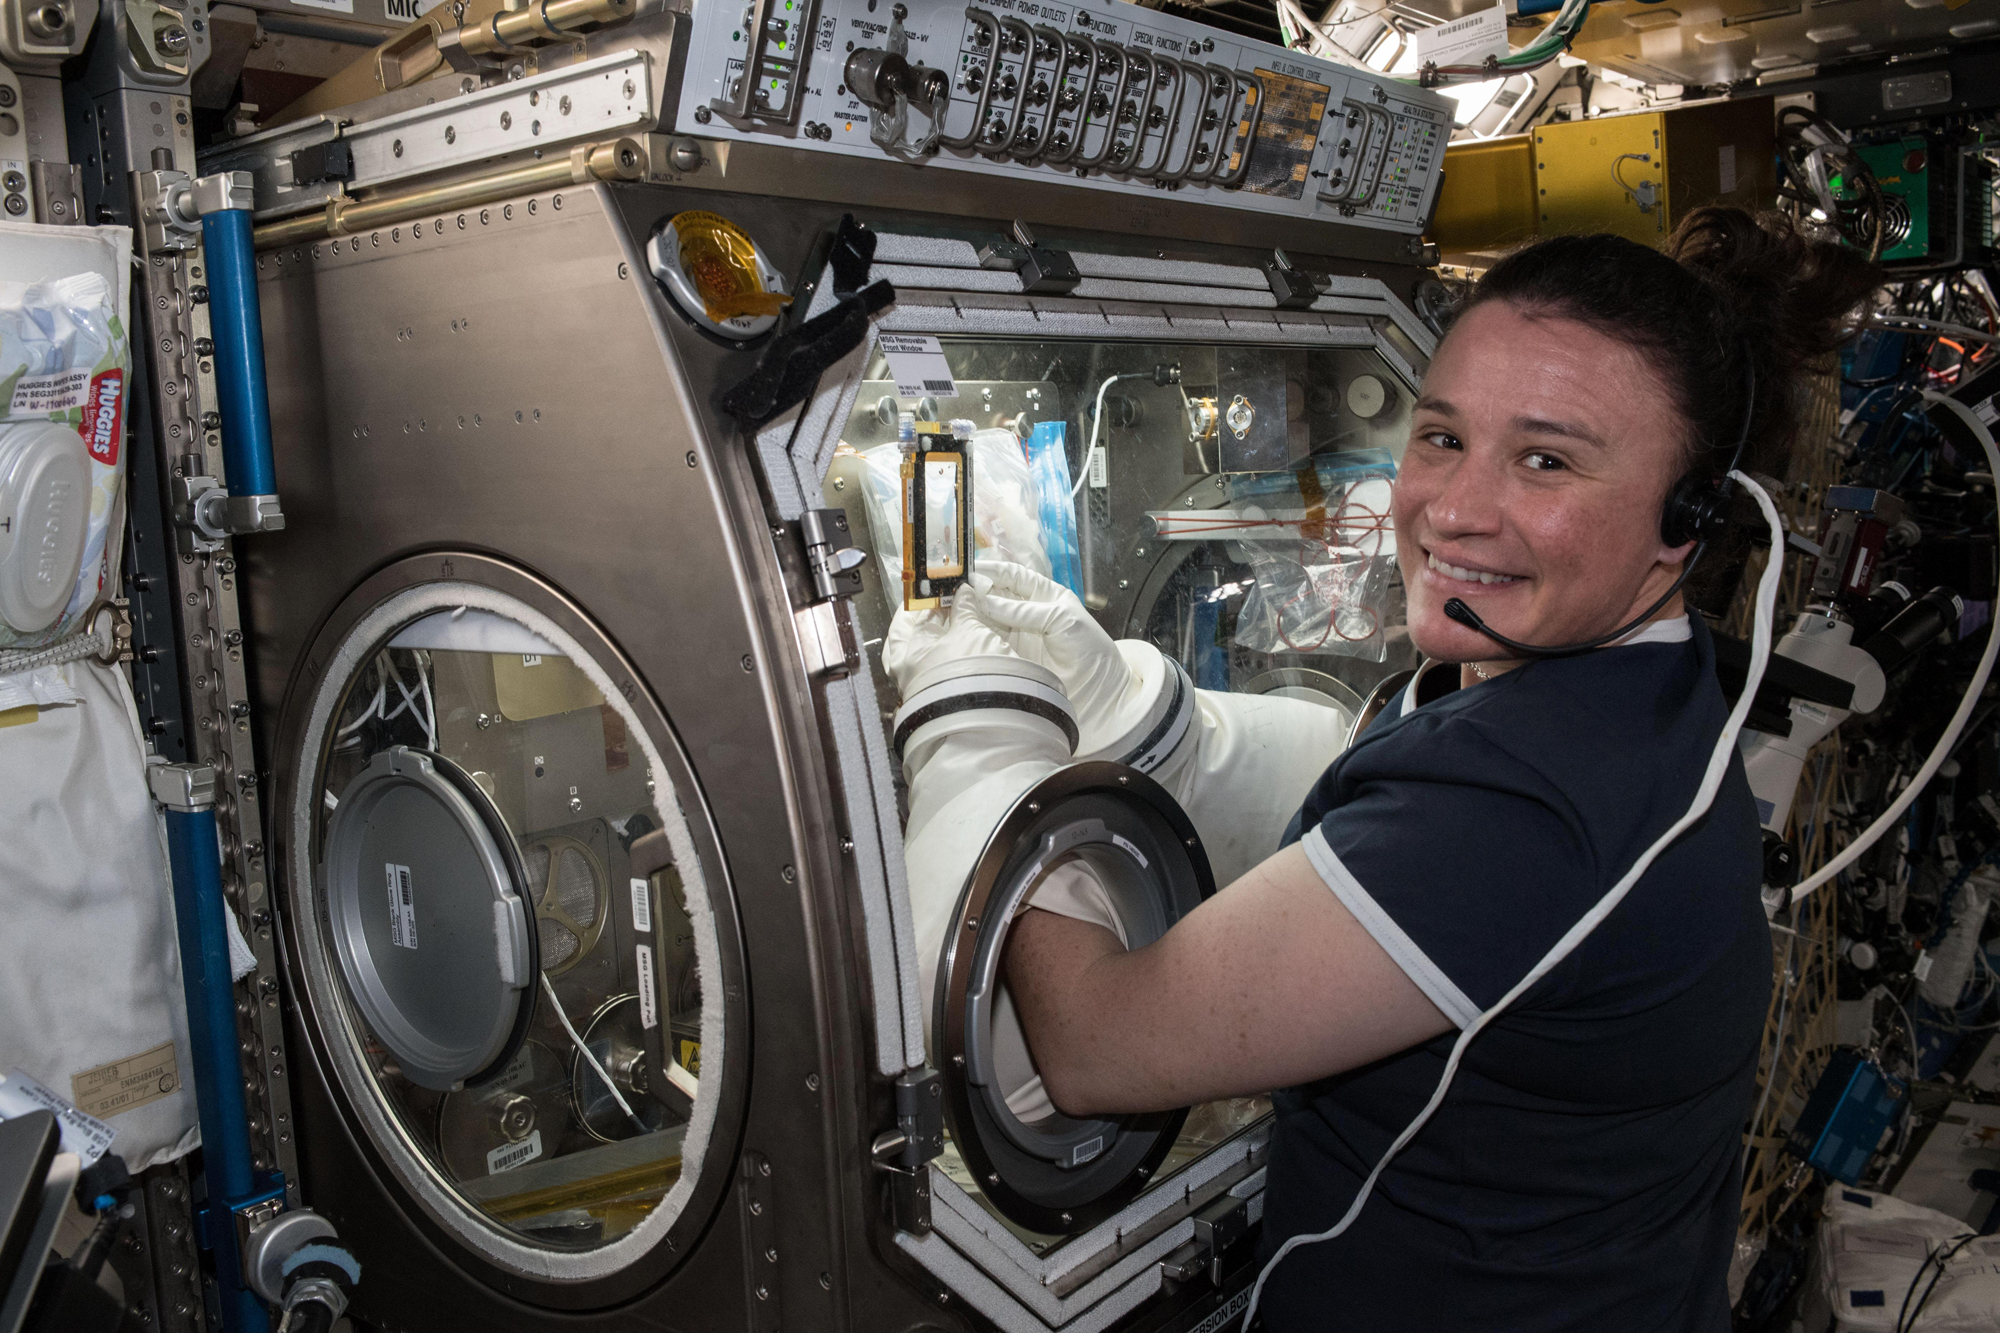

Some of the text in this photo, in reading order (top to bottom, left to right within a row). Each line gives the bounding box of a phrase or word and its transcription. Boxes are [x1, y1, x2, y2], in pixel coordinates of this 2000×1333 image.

[1017, 0, 1039, 16] POWER
[1041, 7, 1066, 23] OUTLETS
[823, 20, 833, 28] +5V
[1088, 19, 1117, 35] FUNCTIONS
[821, 30, 832, 38] +12V
[861, 30, 874, 39] TEST
[904, 30, 917, 40] S422
[819, 40, 831, 49] -12V
[1134, 31, 1154, 46] SPECIAL
[1155, 37, 1183, 52] FUNCTIONS
[1068, 76, 1078, 84] MODE
[1403, 105, 1417, 116] HEALTH
[834, 111, 868, 123] MASTER CAUTION
[896, 336, 927, 345] Removable
[882, 344, 899, 352] Front
[17, 380, 52, 390] HUGGIES
[69, 373, 88, 382] ASSY
[15, 391, 28, 399] P/N
[89, 384, 98, 408] wipes
[93, 378, 121, 455] HUGGIES
[85, 1144, 101, 1159] P2
[1190, 1289, 1250, 1333] ERSION BOX
